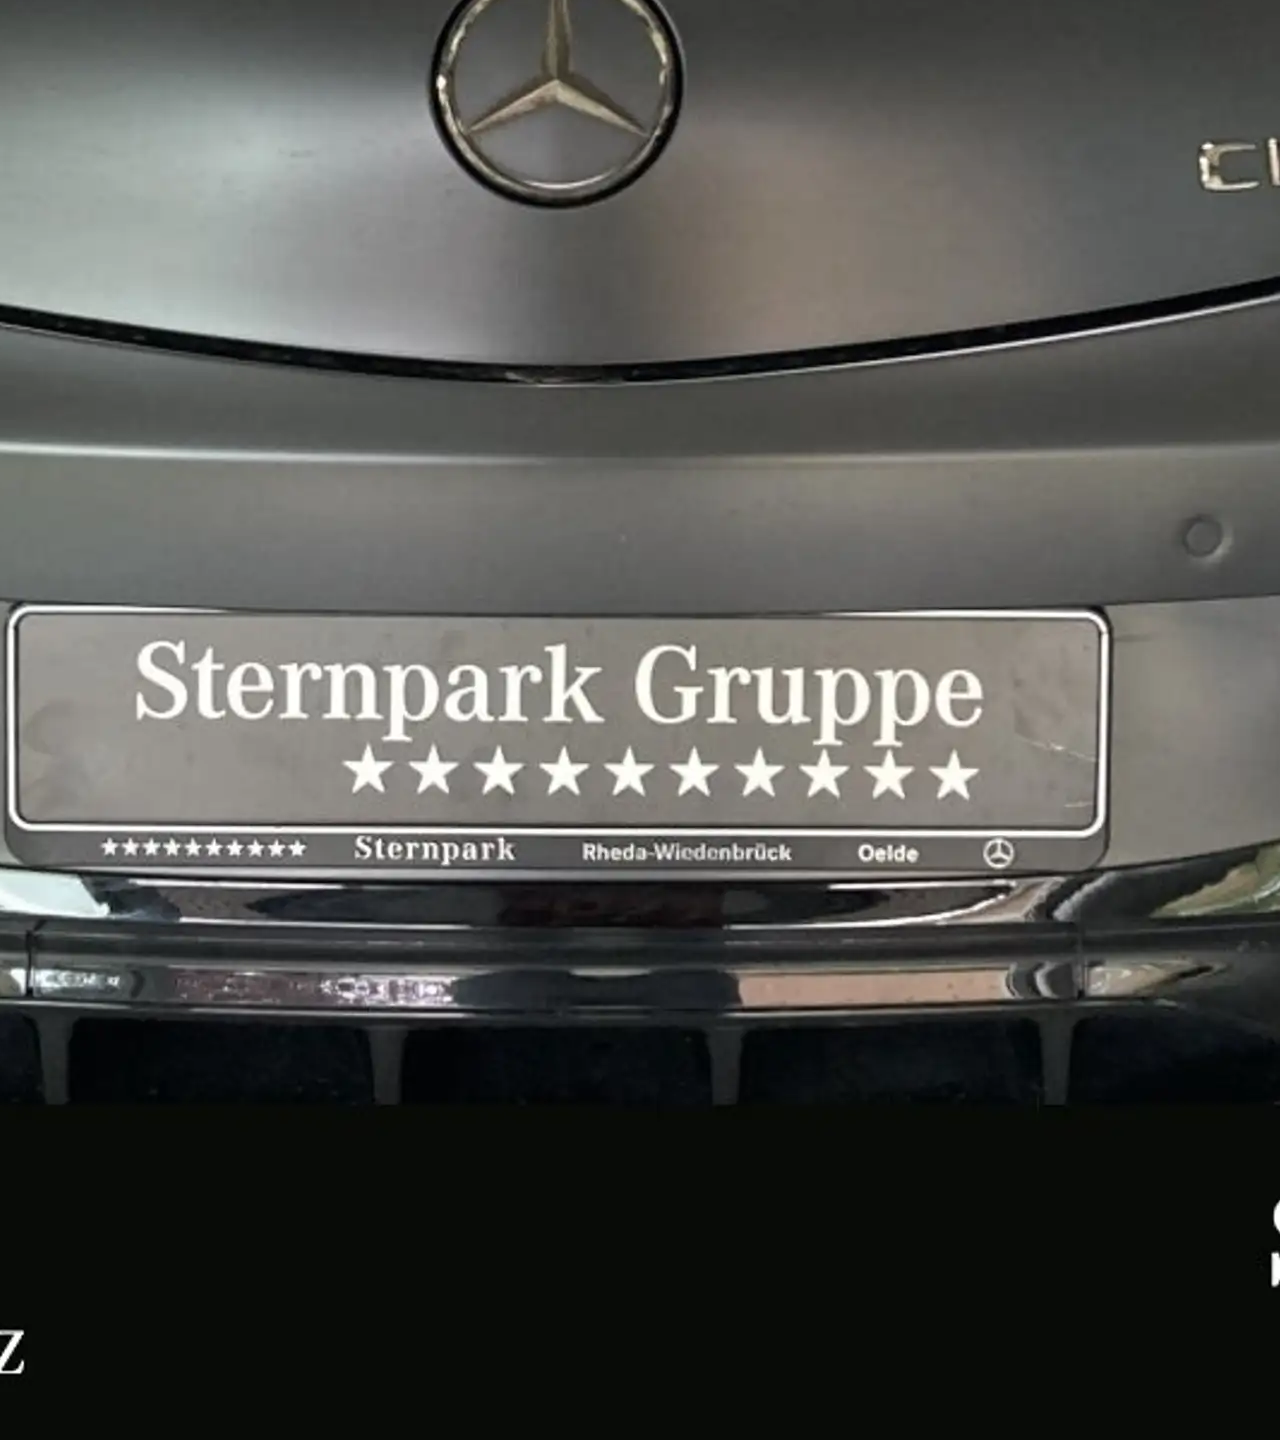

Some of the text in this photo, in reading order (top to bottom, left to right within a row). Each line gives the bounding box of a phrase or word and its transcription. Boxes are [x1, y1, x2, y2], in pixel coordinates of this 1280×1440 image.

[135, 639, 985, 748] Sternpark Gruppe
[353, 835, 920, 866] Sternpark Rheda-Wiedenbrück Oelde
